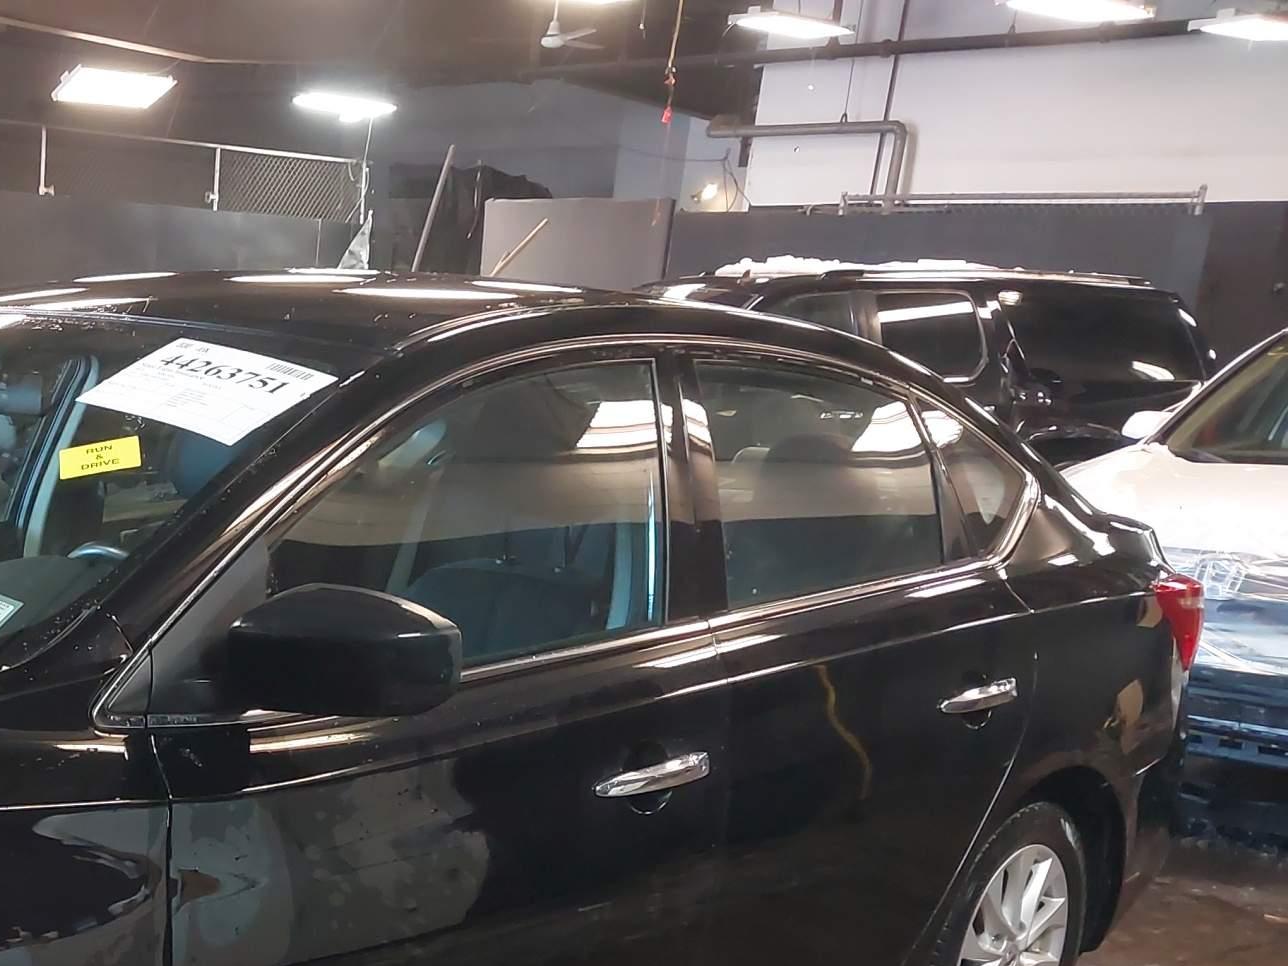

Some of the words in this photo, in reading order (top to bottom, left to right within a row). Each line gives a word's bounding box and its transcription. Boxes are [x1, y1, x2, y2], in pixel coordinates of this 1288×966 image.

[160, 354, 290, 394] 44263751
[85, 445, 113, 455] RUN
[80, 458, 121, 471] DRIVE
